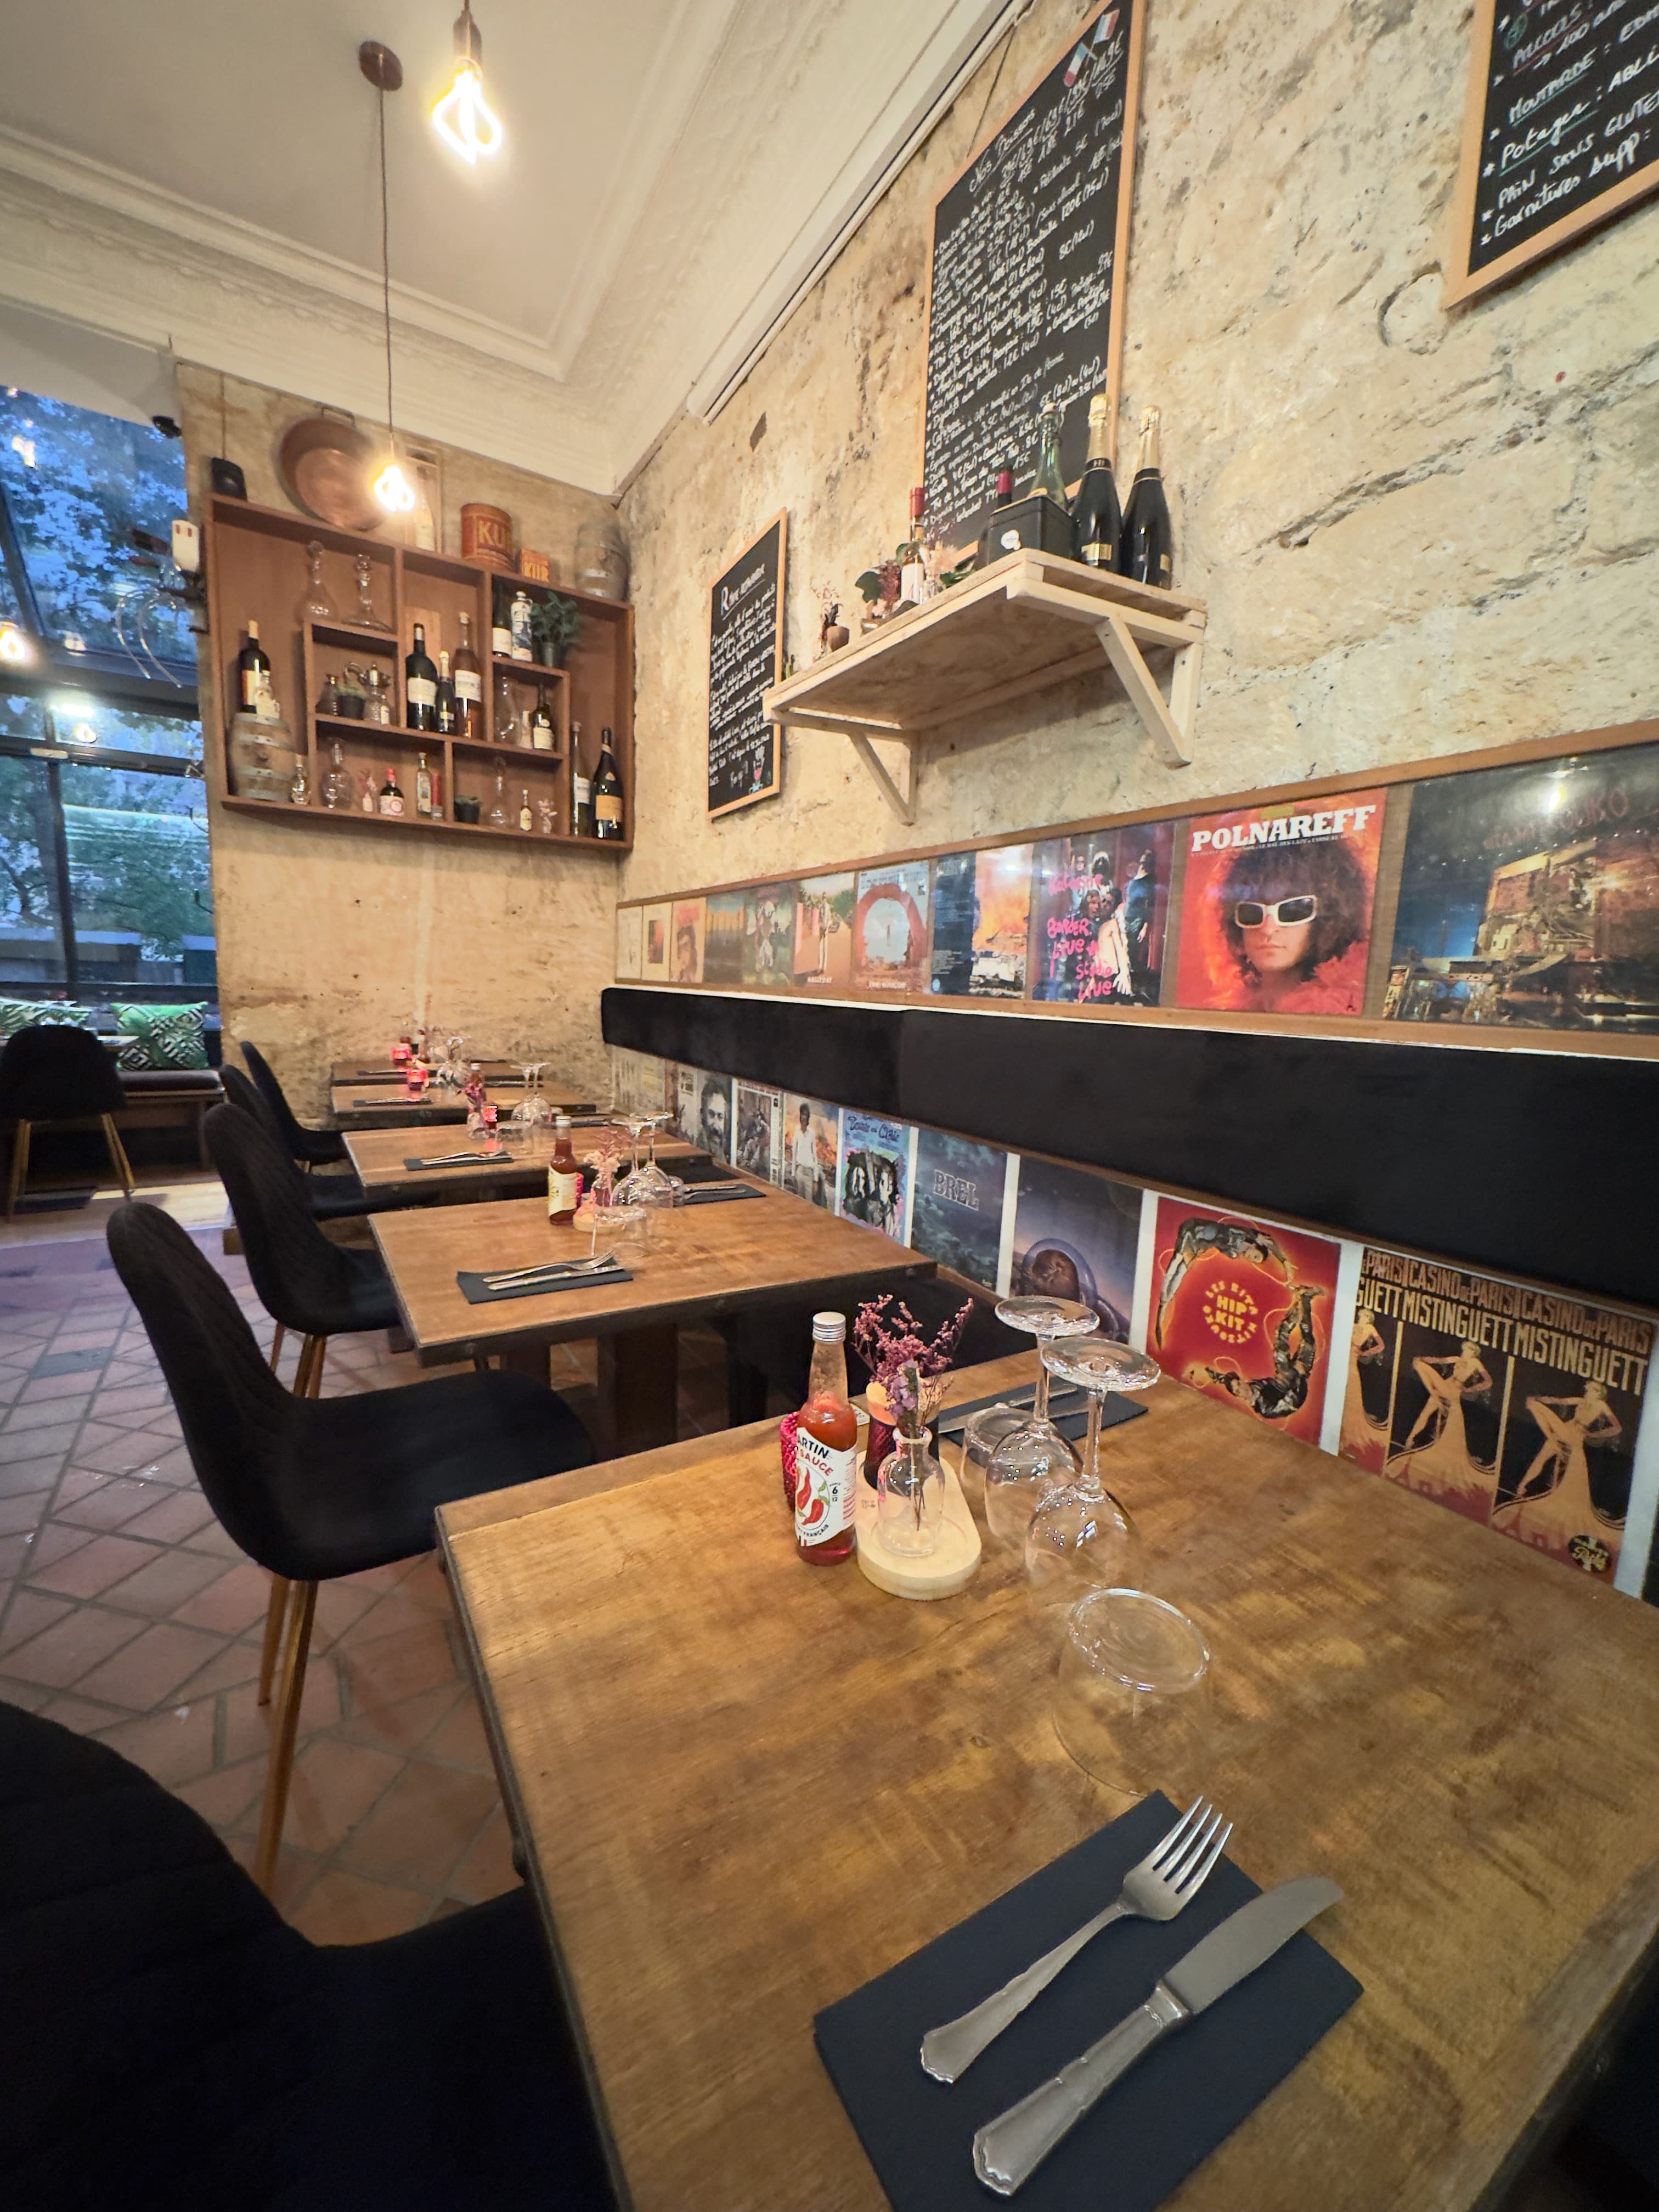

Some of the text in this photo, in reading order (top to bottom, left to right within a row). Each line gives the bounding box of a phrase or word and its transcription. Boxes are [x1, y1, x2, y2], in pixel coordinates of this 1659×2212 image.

[1191, 804, 1377, 852] POLNAREFF
[933, 1169, 979, 1211] BREL
[1217, 1295, 1247, 1315] HIP
[1409, 1261, 1462, 1300] CASINO
[1470, 1277, 1515, 1314] PARIS
[1521, 1290, 1586, 1335] CASINO
[1596, 1311, 1652, 1355] PARIS
[1215, 1310, 1244, 1331] KIT
[1402, 1289, 1514, 1352] MISTINGUETT
[1513, 1321, 1647, 1396] MISTINGUETT
[797, 1434, 829, 1459] ARTIN
[799, 1449, 833, 1476] SAUCE
[832, 1486, 838, 1494] 6
